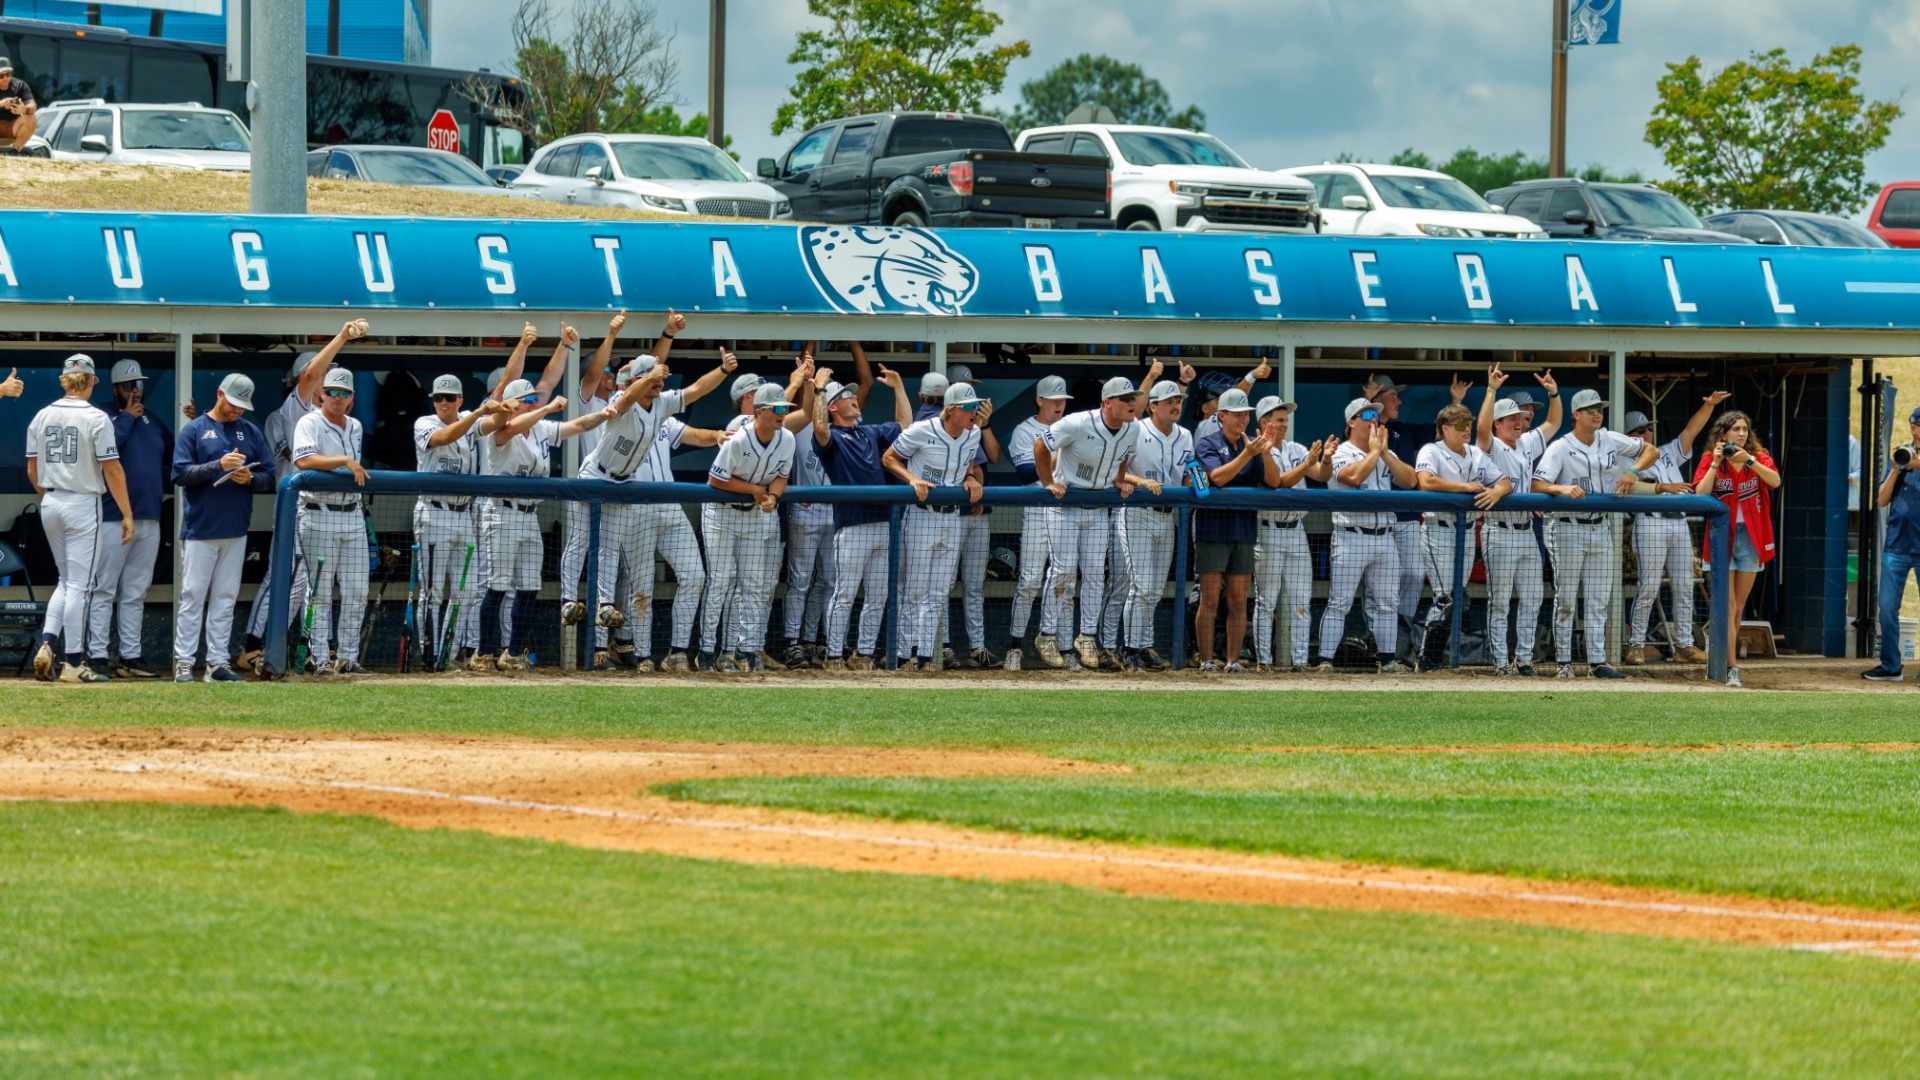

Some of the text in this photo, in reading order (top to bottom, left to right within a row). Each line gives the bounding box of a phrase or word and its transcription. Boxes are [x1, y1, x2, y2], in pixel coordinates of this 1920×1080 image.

[430, 127, 458, 151] STOP
[1023, 245, 1796, 313] BASEBALL
[45, 425, 78, 464] 20
[613, 435, 635, 457] 19
[438, 457, 460, 474] 35
[922, 464, 943, 484] 28
[1076, 462, 1095, 481] 10
